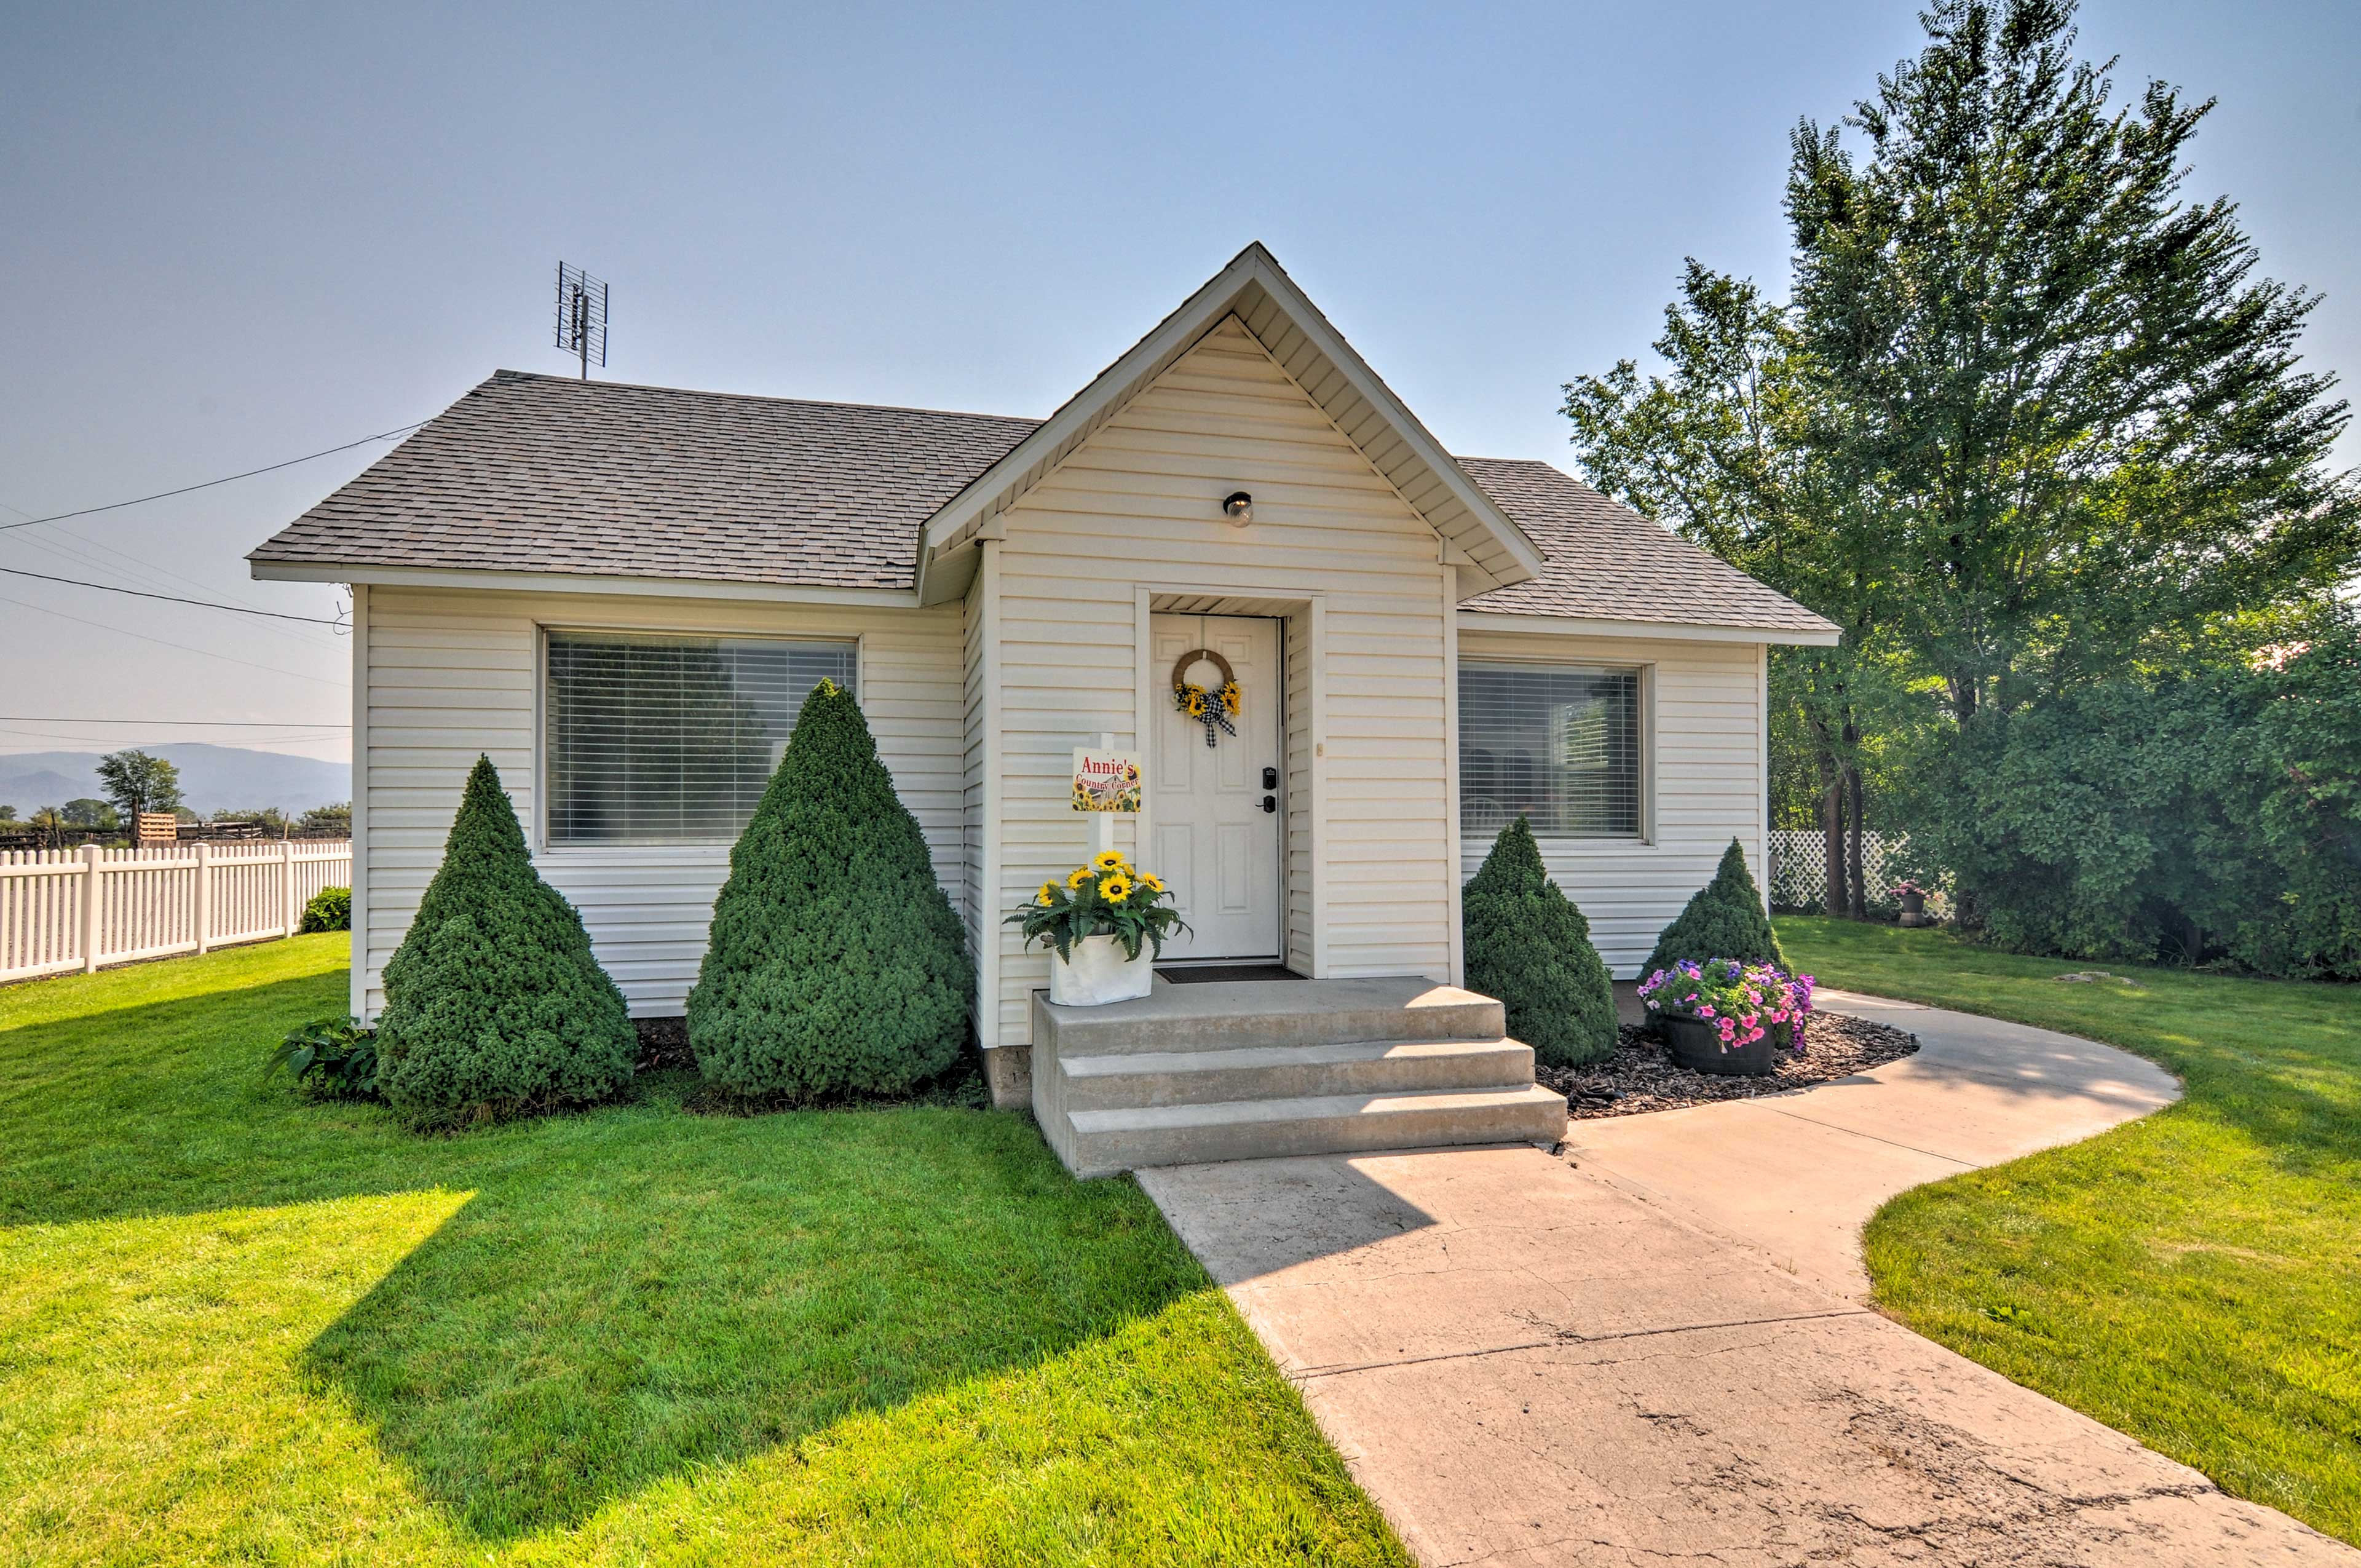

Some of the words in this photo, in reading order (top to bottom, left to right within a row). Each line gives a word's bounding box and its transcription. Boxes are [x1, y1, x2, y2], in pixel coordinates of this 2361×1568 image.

[1082, 757, 1133, 775] Annie's
[1076, 774, 1109, 791] Country
[1112, 778, 1139, 790] Corner
